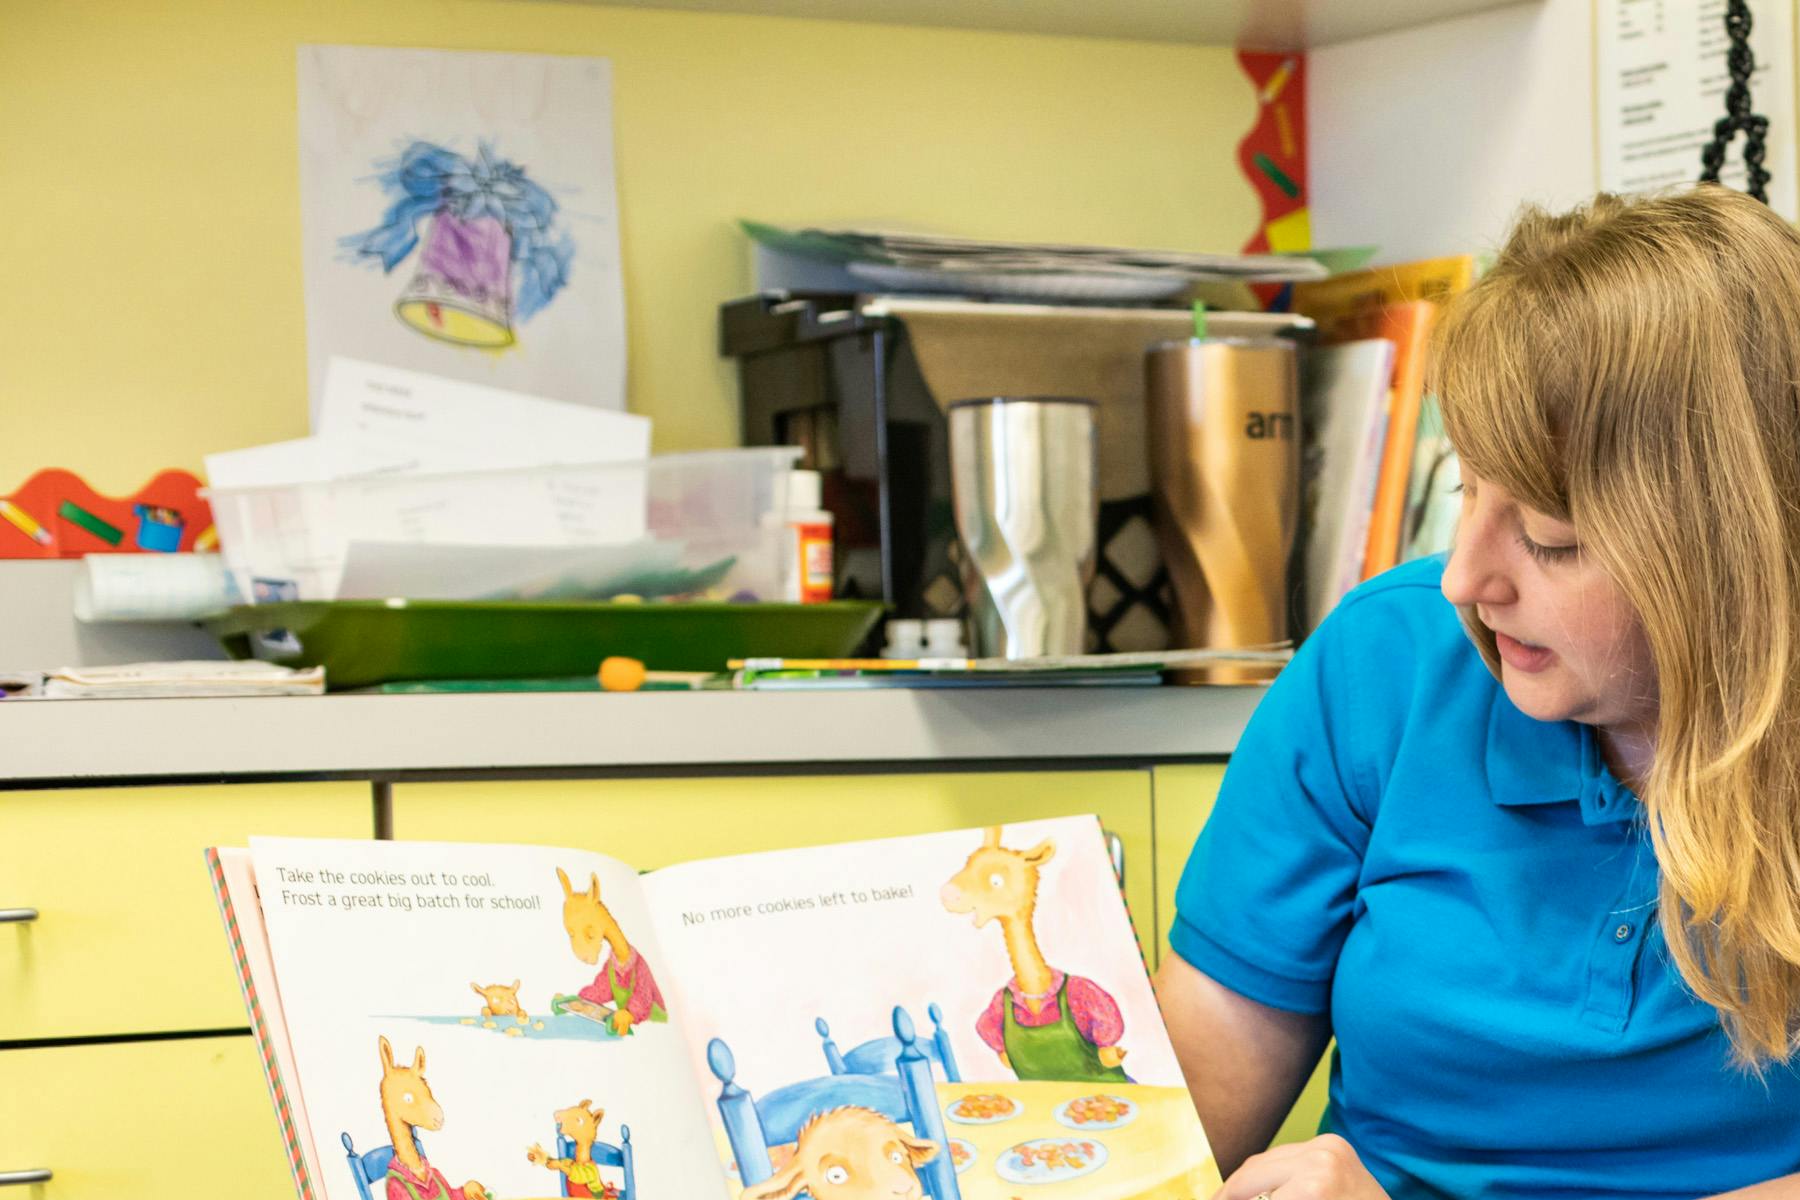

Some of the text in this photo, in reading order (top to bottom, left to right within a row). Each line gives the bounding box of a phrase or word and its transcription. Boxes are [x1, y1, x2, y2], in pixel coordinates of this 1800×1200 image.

[275, 867, 496, 887] Take the cookies out to cool.
[281, 890, 542, 912] Frost a great big batch for school!
[682, 884, 914, 927] No more cookies left to bake!
